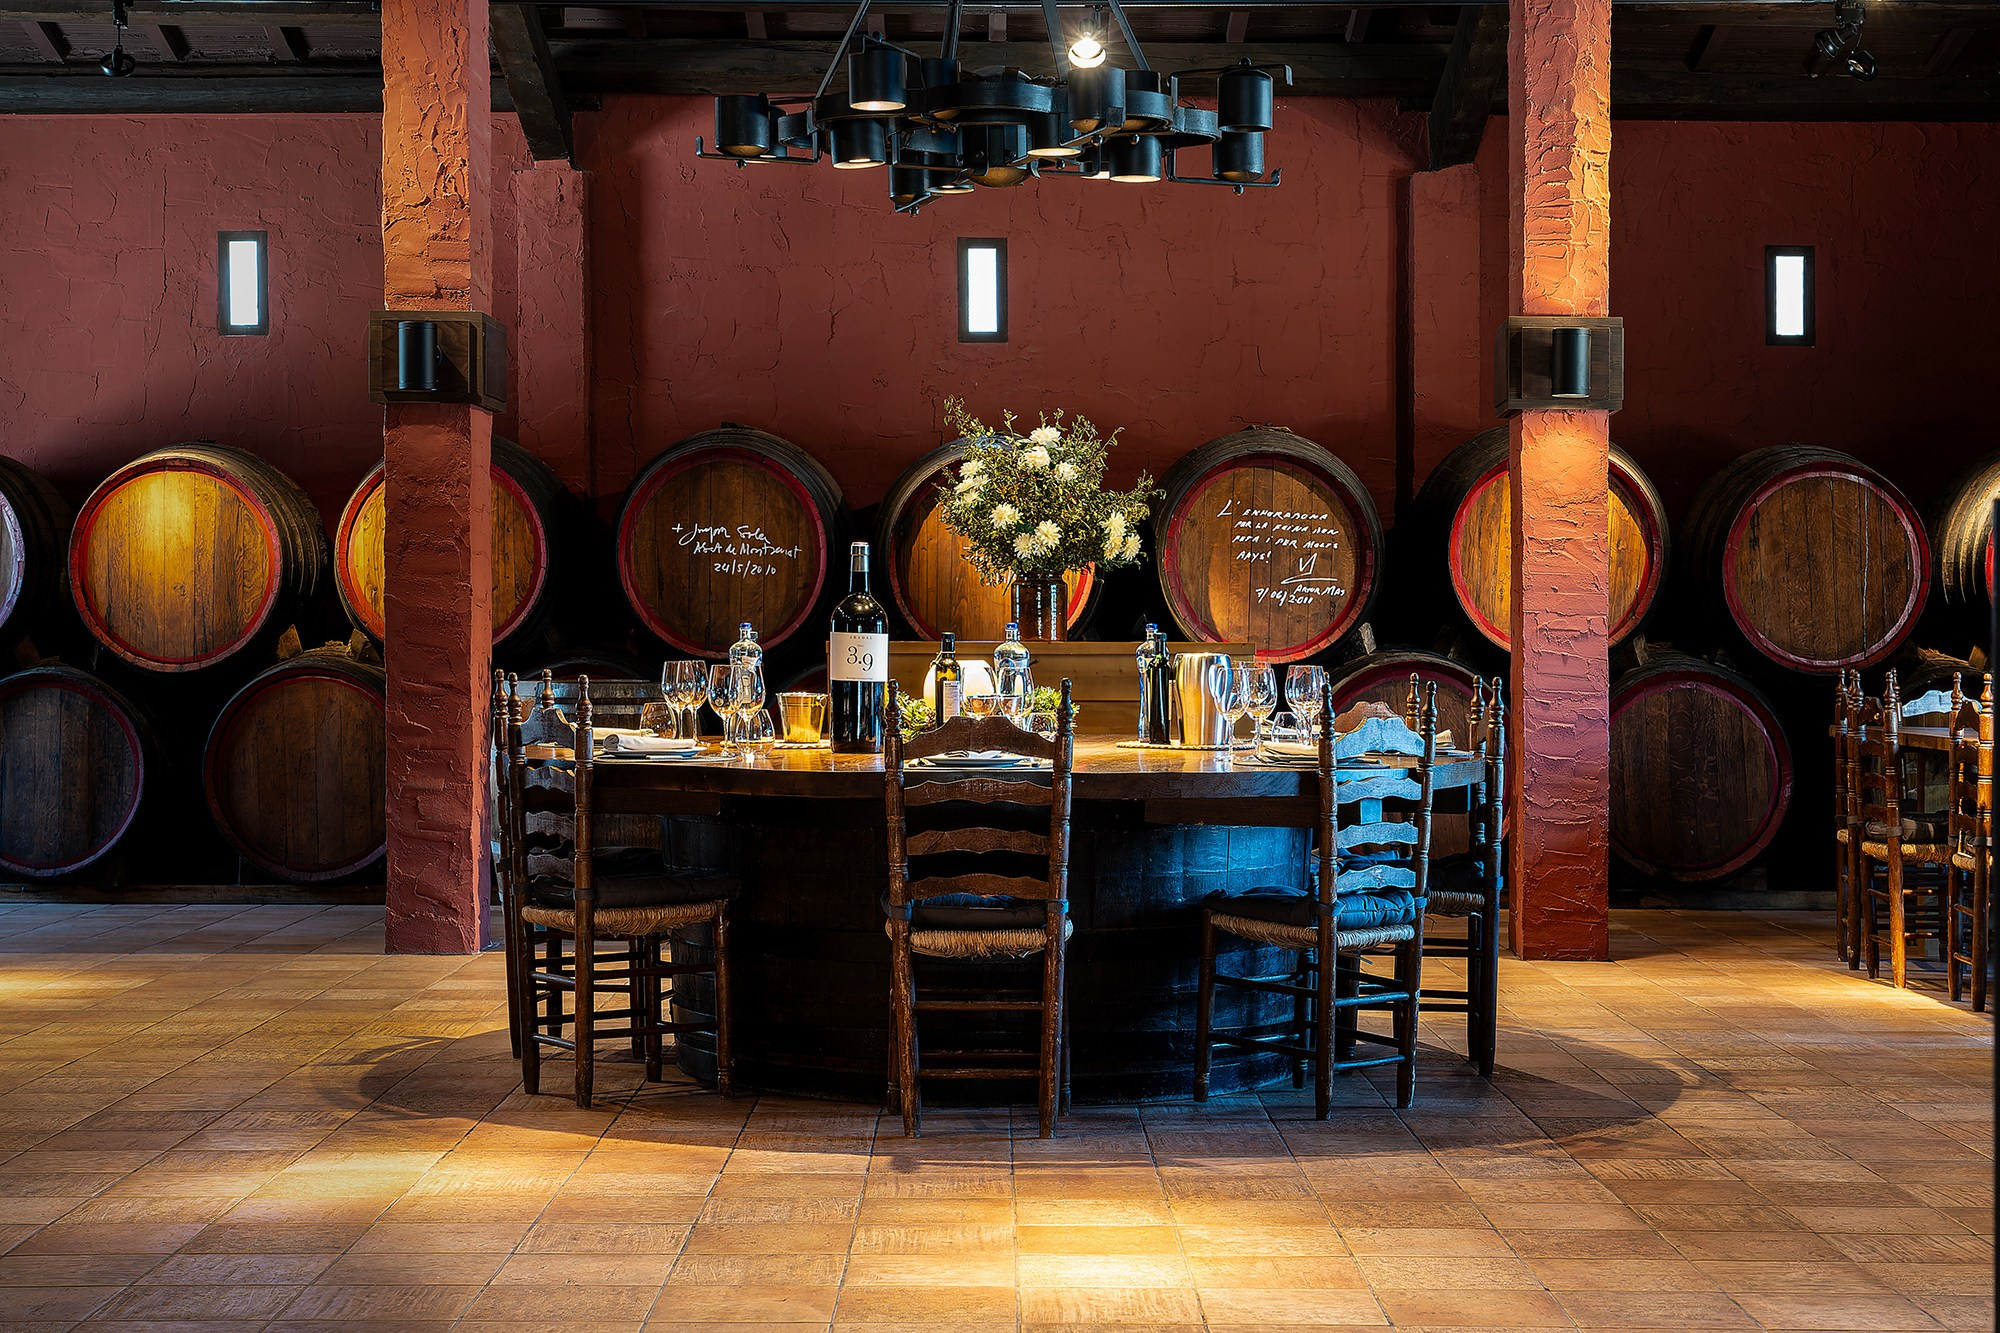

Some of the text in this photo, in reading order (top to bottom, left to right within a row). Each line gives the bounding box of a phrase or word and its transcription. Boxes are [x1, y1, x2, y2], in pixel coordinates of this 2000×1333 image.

[1234, 520, 1252, 529] PER
[1255, 521, 1268, 529] LA
[725, 543, 737, 555] de
[1275, 538, 1298, 549] PER
[713, 559, 777, 579] 24/5/2010
[846, 645, 874, 672] 3.9
